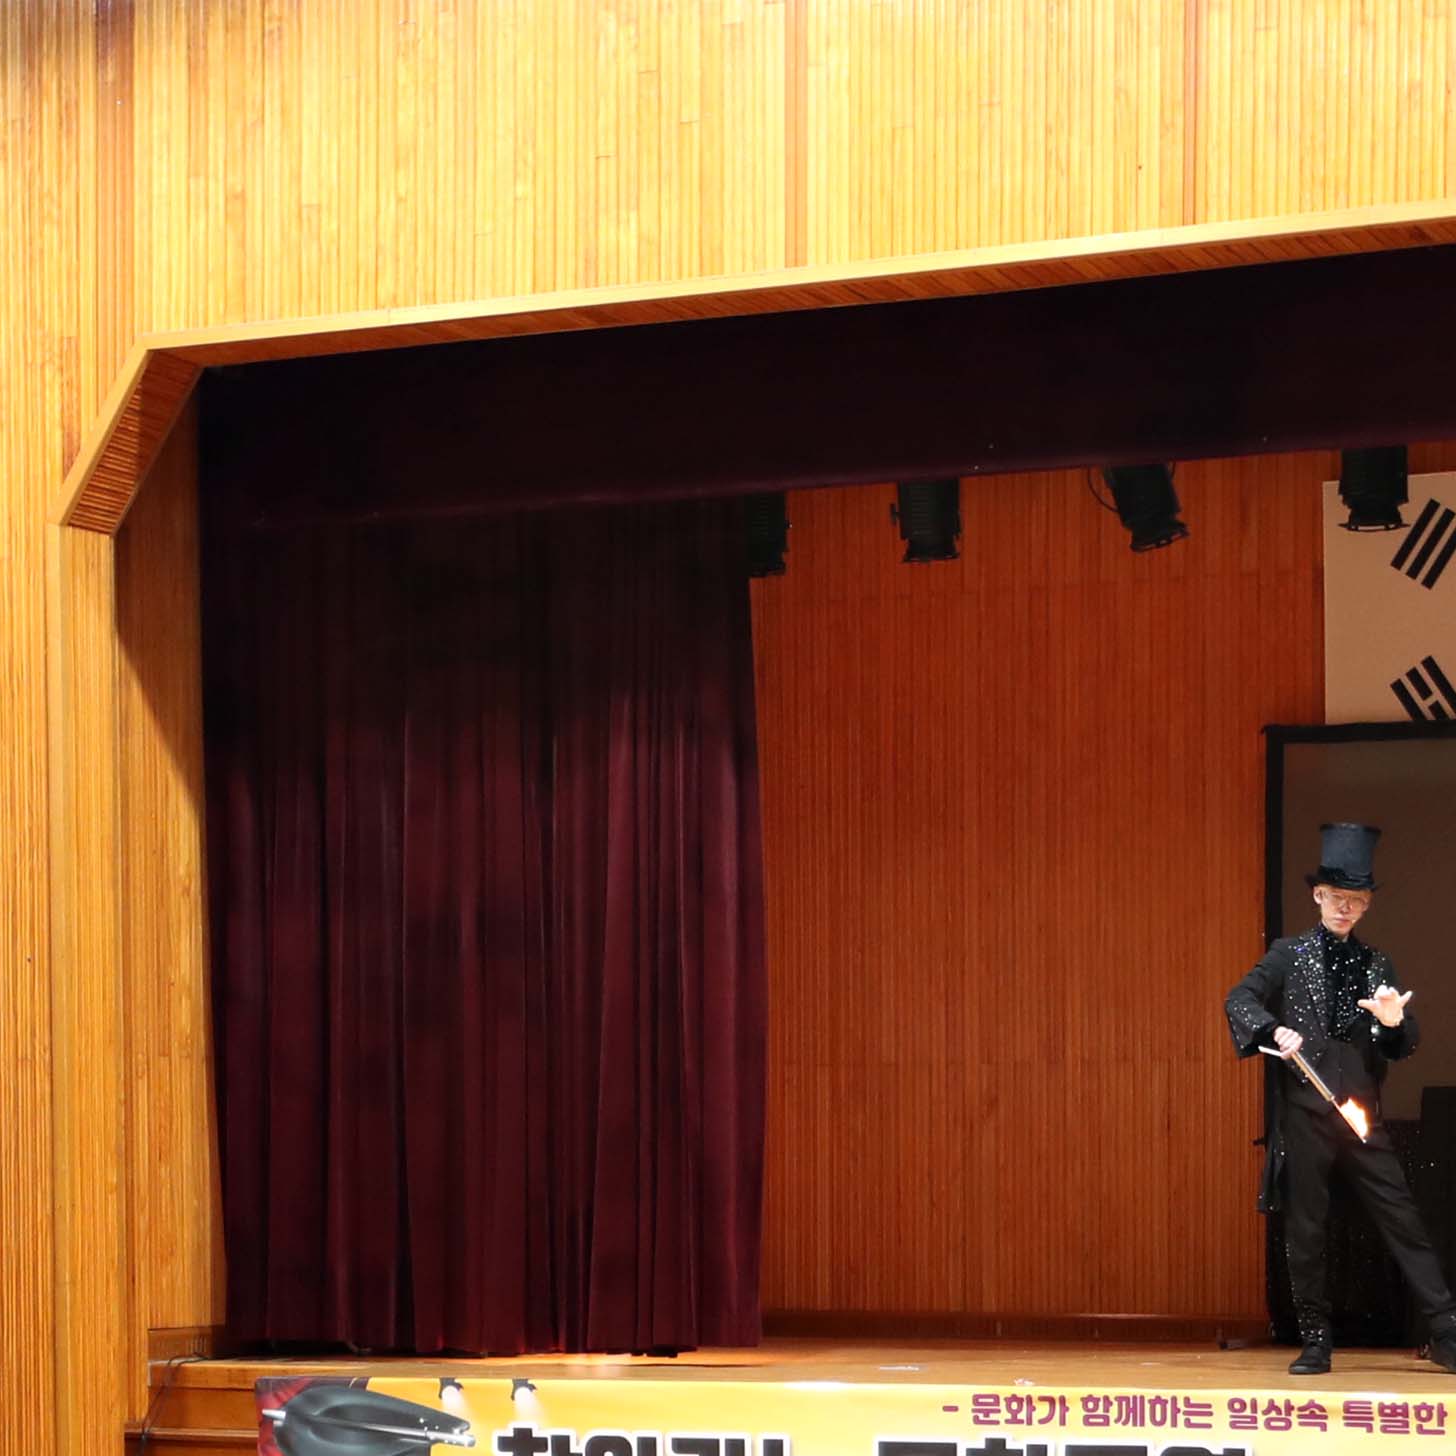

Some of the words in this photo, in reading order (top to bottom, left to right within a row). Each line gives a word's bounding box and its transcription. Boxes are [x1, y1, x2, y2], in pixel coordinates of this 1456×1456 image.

[971, 1393, 1070, 1427] 문화가
[1080, 1394, 1214, 1430] 함께하는
[1227, 1397, 1329, 1433] 일상속
[1342, 1400, 1448, 1436] 특별한
